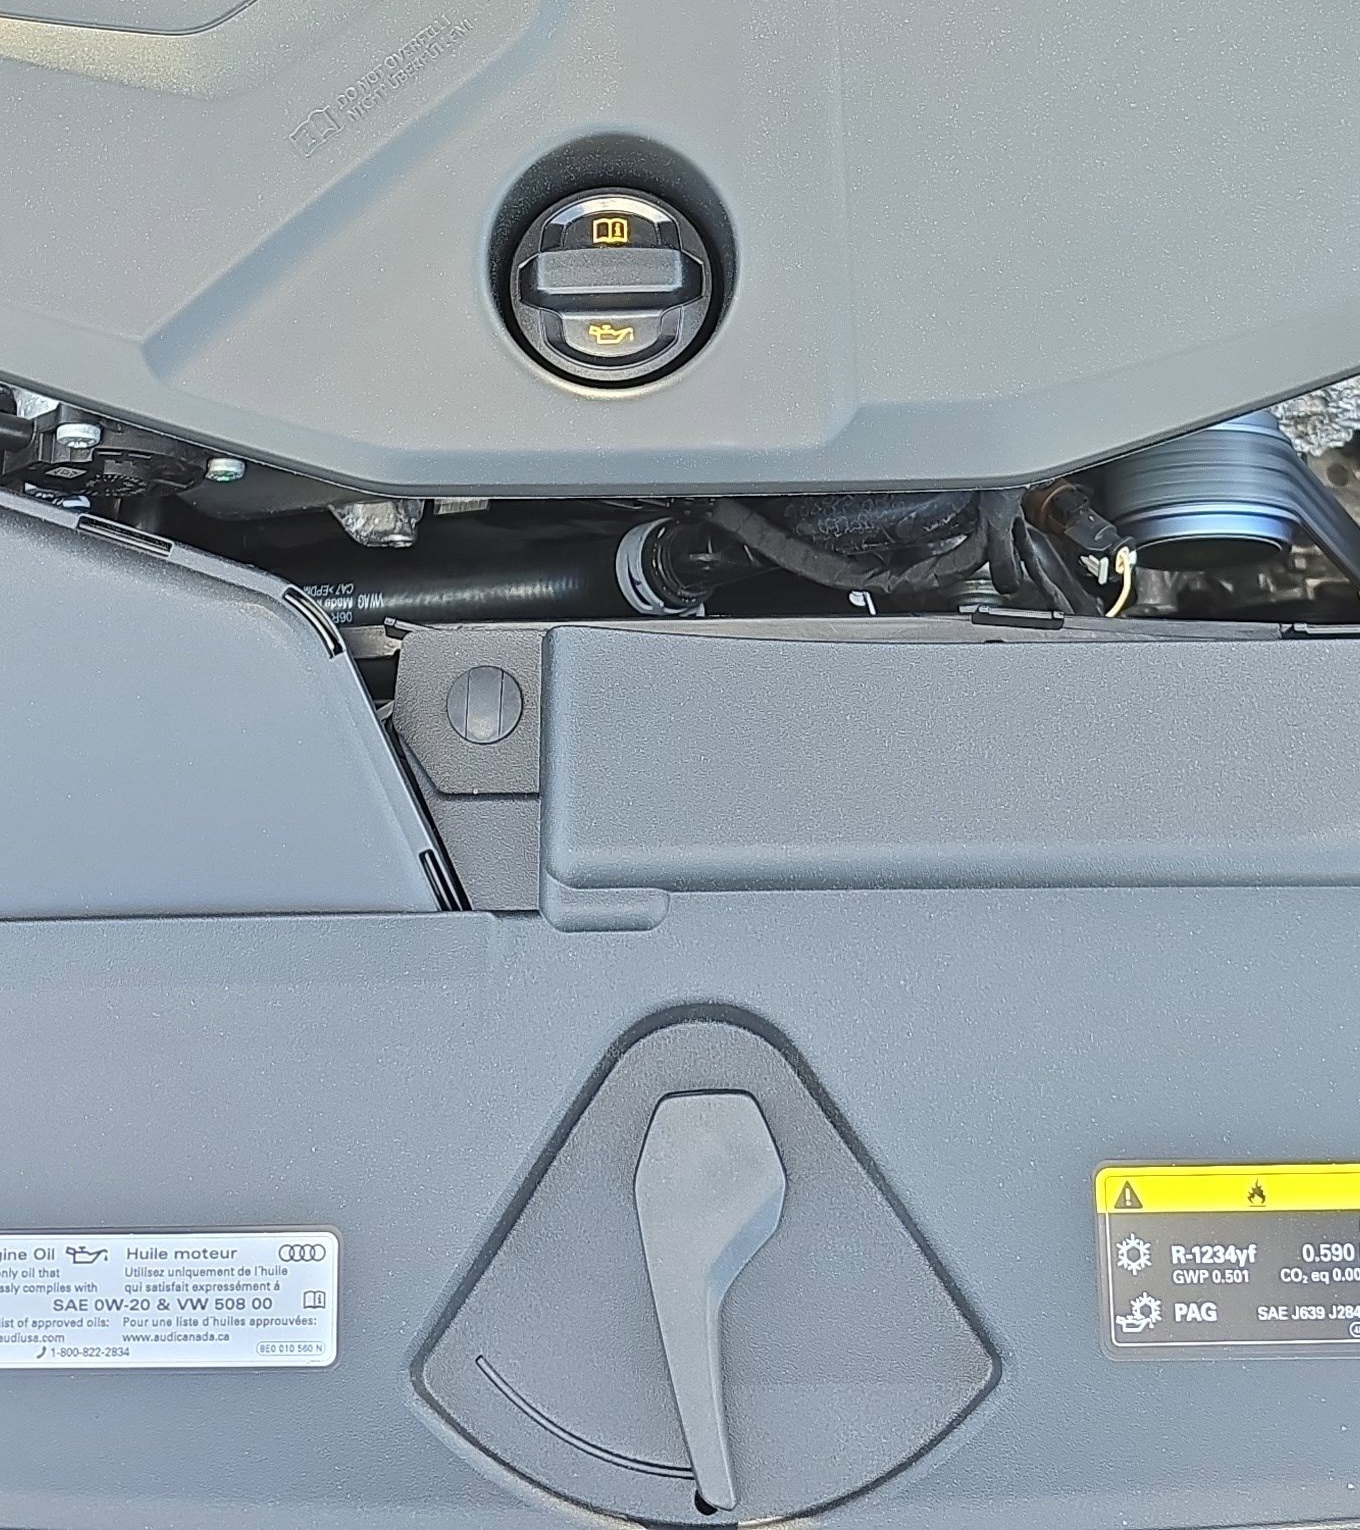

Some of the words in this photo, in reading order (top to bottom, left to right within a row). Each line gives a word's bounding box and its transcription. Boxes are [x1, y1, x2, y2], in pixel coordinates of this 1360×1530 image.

[324, 597, 353, 609] Made
[34, 1248, 55, 1260] Oil
[126, 1247, 168, 1260] Huile
[174, 1248, 237, 1259] moteur
[1171, 1244, 1257, 1267] R-1234yf
[1302, 1243, 1354, 1263] 0.590
[22, 1268, 35, 1278] oil
[39, 1267, 59, 1278] that
[125, 1266, 164, 1277] Utilisez
[168, 1266, 234, 1279] uniquement
[238, 1266, 251, 1276] de
[1173, 1270, 1209, 1284] GWP
[1212, 1269, 1250, 1283] 0.501
[1311, 1270, 1330, 1284] eq
[23, 1282, 71, 1294] complies
[74, 1282, 97, 1292] with
[125, 1282, 142, 1294] qui
[145, 1281, 188, 1292] satisfait
[192, 1281, 270, 1293] expressément
[53, 1298, 88, 1312] SAE
[94, 1298, 150, 1311] 0W-20
[157, 1298, 170, 1311] &
[177, 1298, 208, 1310] VW
[215, 1298, 246, 1310] 508
[252, 1297, 272, 1310] 00
[1174, 1303, 1218, 1322] PAG
[1258, 1306, 1288, 1320] SAE
[1292, 1306, 1325, 1319] J639
[18, 1317, 28, 1327] of
[32, 1317, 83, 1329] approved
[87, 1317, 109, 1327] oils:
[123, 1317, 148, 1326] Pour
[152, 1318, 172, 1326] une
[176, 1316, 198, 1326] liste
[250, 1316, 317, 1328] approuvées:
[122, 1332, 230, 1342] www.audicanada.ca
[51, 1347, 129, 1357] 1-800-822-2834
[279, 1344, 294, 1352] 010
[316, 1344, 322, 1352] N
